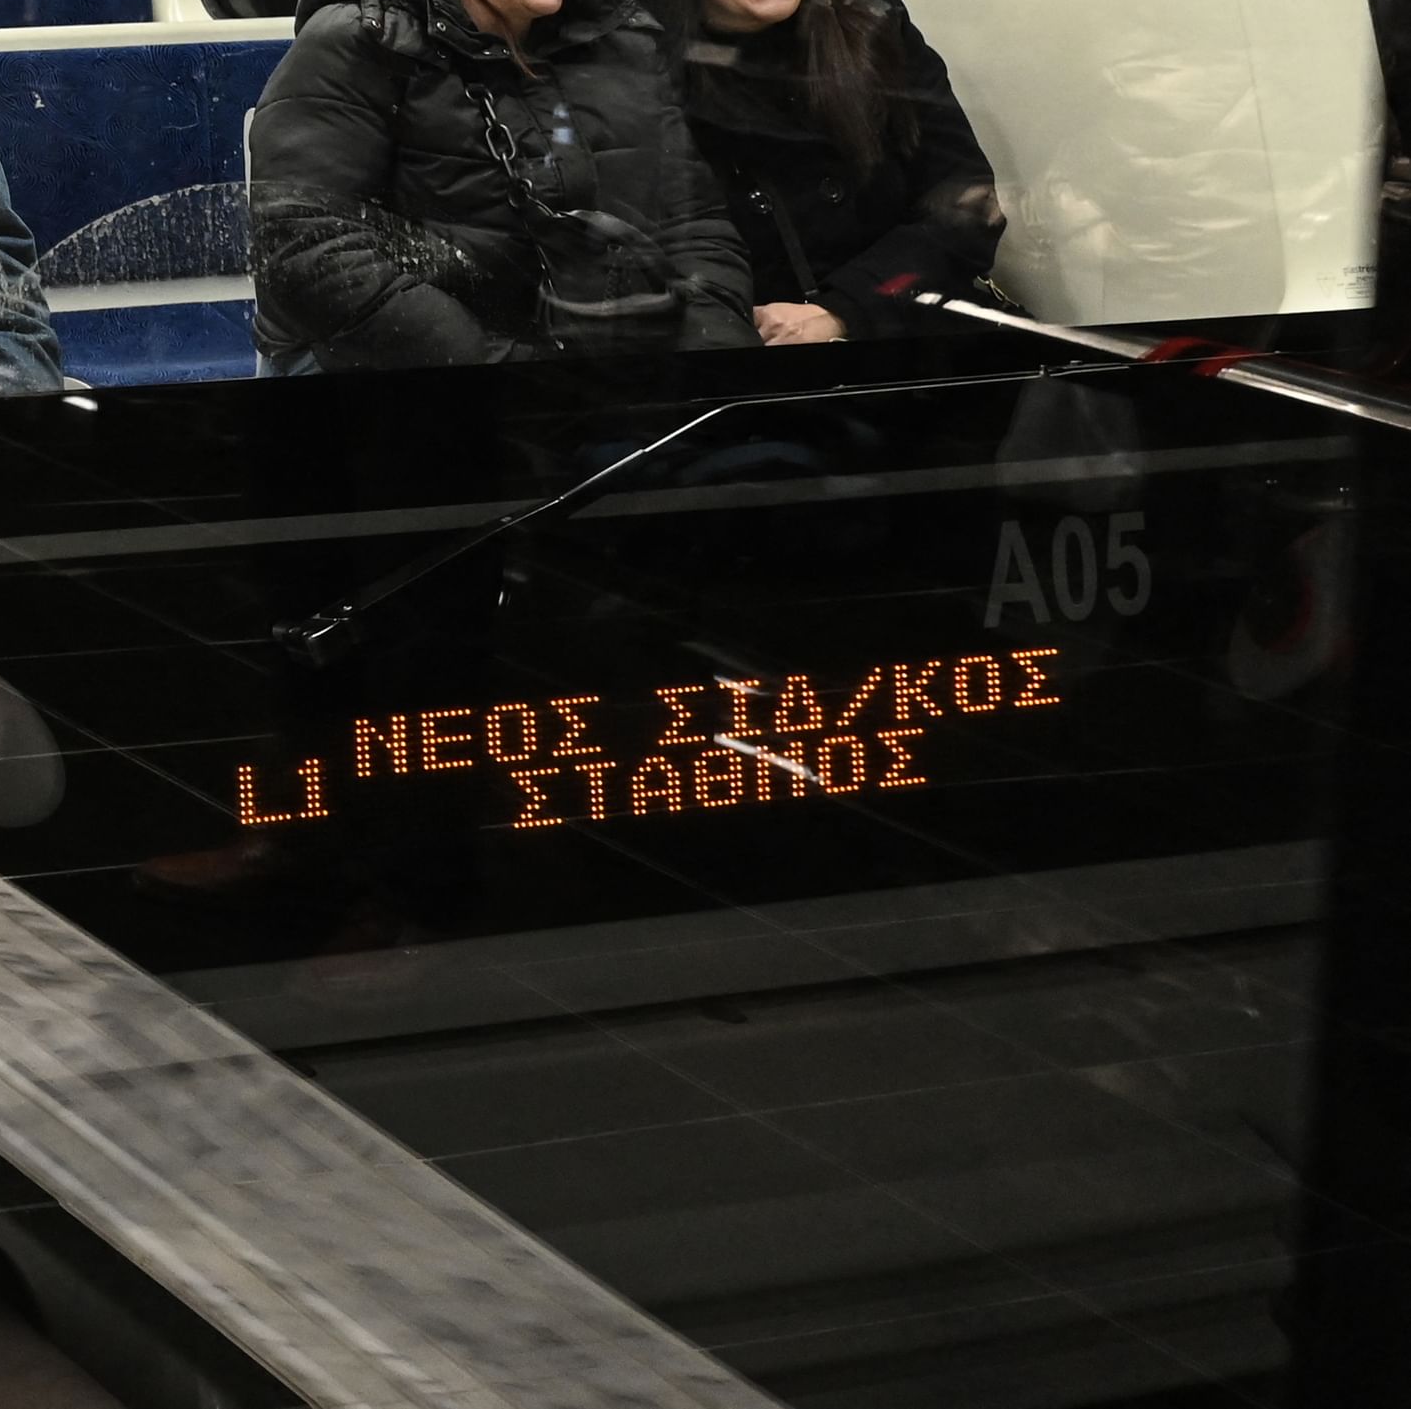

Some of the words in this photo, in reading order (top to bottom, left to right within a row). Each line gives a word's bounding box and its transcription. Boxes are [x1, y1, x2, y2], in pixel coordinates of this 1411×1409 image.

[983, 510, 1153, 629] A05
[354, 694, 602, 778] ΝΕΟΣ
[510, 727, 928, 830] ΣΤΑΘΜΟΣ
[237, 757, 330, 826] L1
